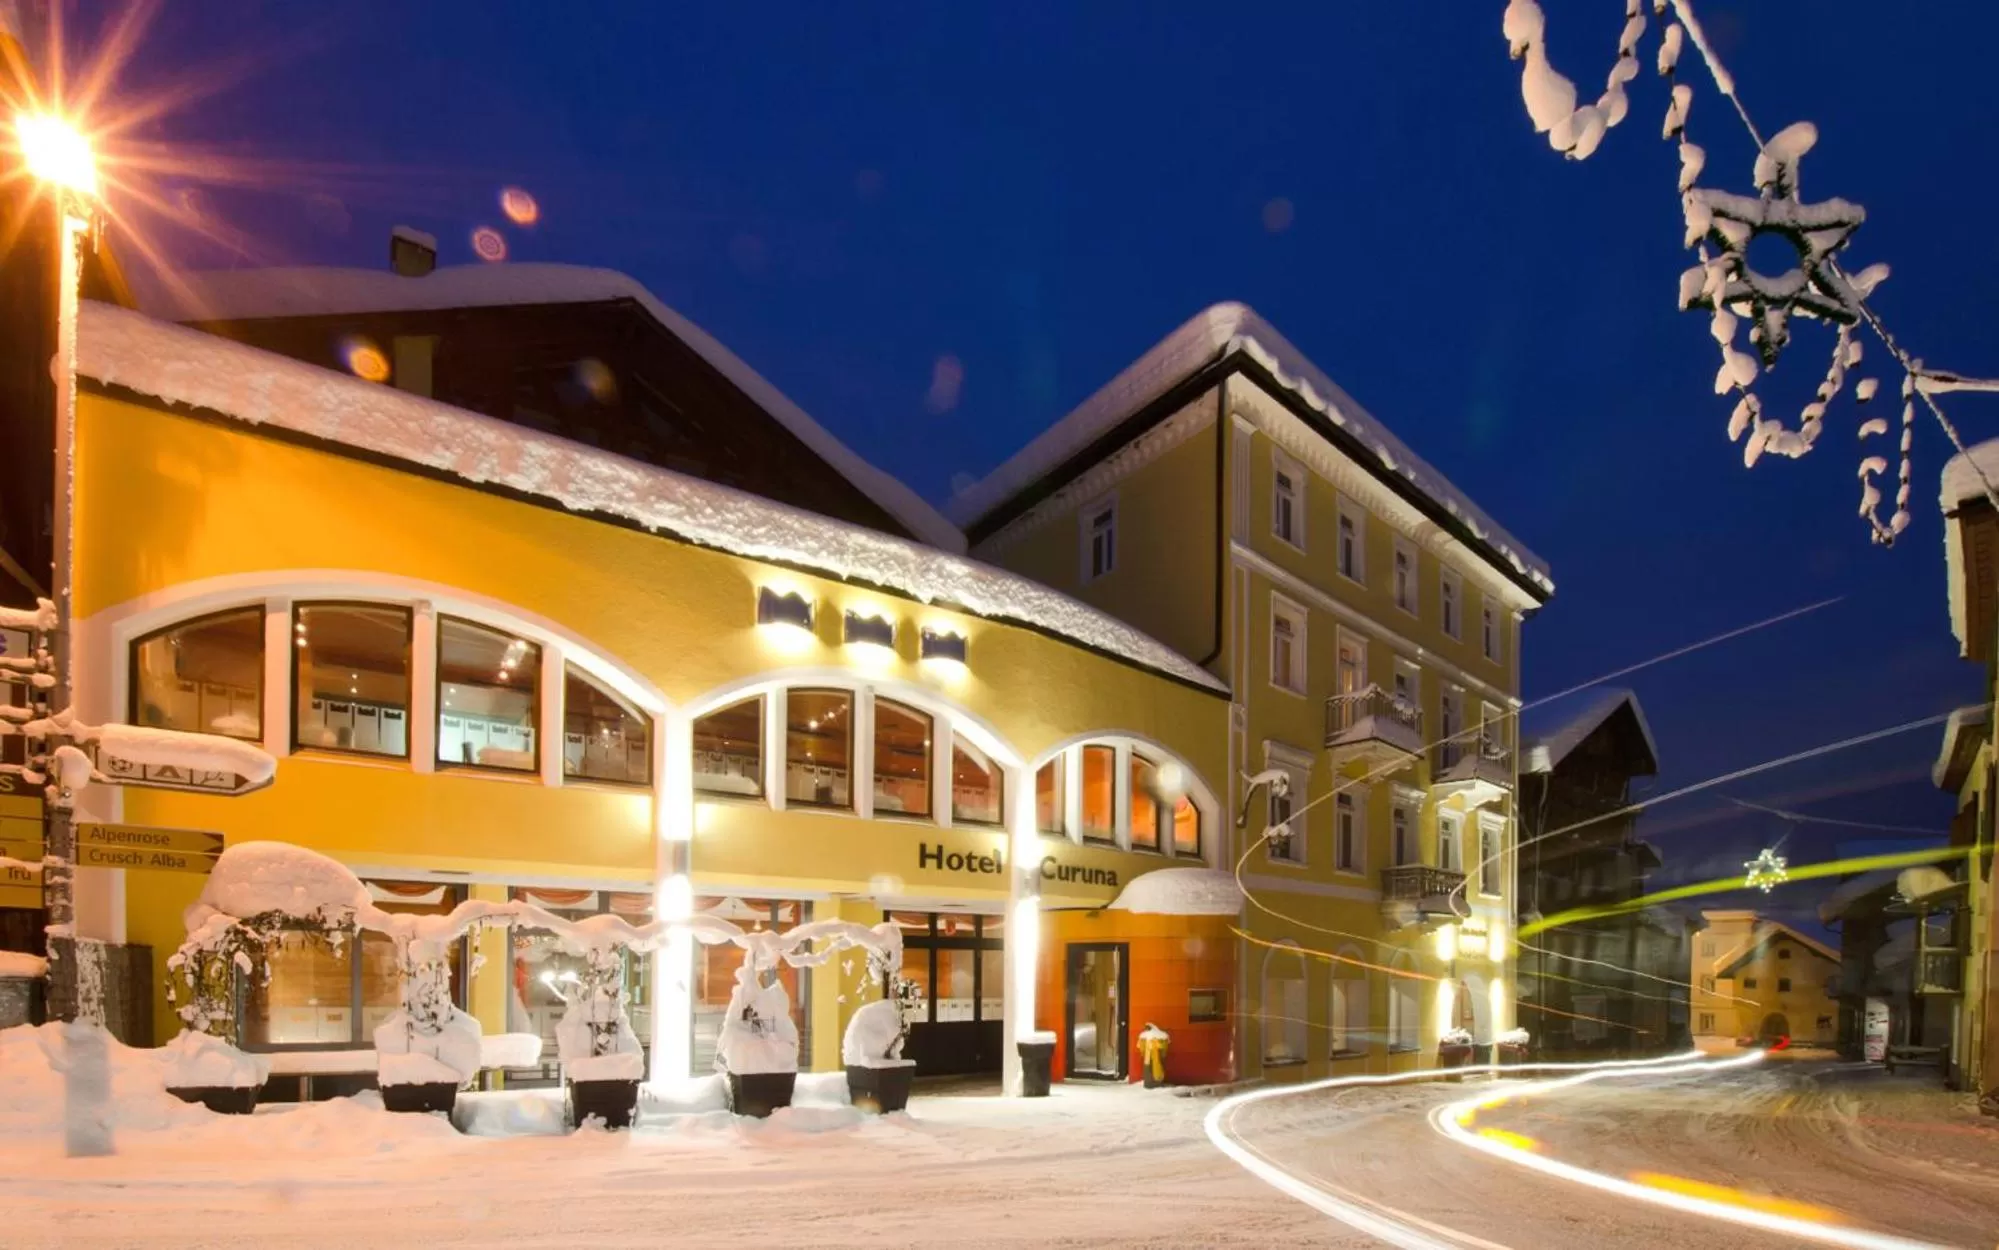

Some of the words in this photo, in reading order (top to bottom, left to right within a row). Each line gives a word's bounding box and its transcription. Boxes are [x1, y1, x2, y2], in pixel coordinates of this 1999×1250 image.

[89, 826, 171, 846] Alpenrose
[88, 849, 143, 866] Crusch
[150, 853, 187, 869] Alba
[918, 842, 1003, 875] Hotel
[1039, 855, 1119, 887] Curuna
